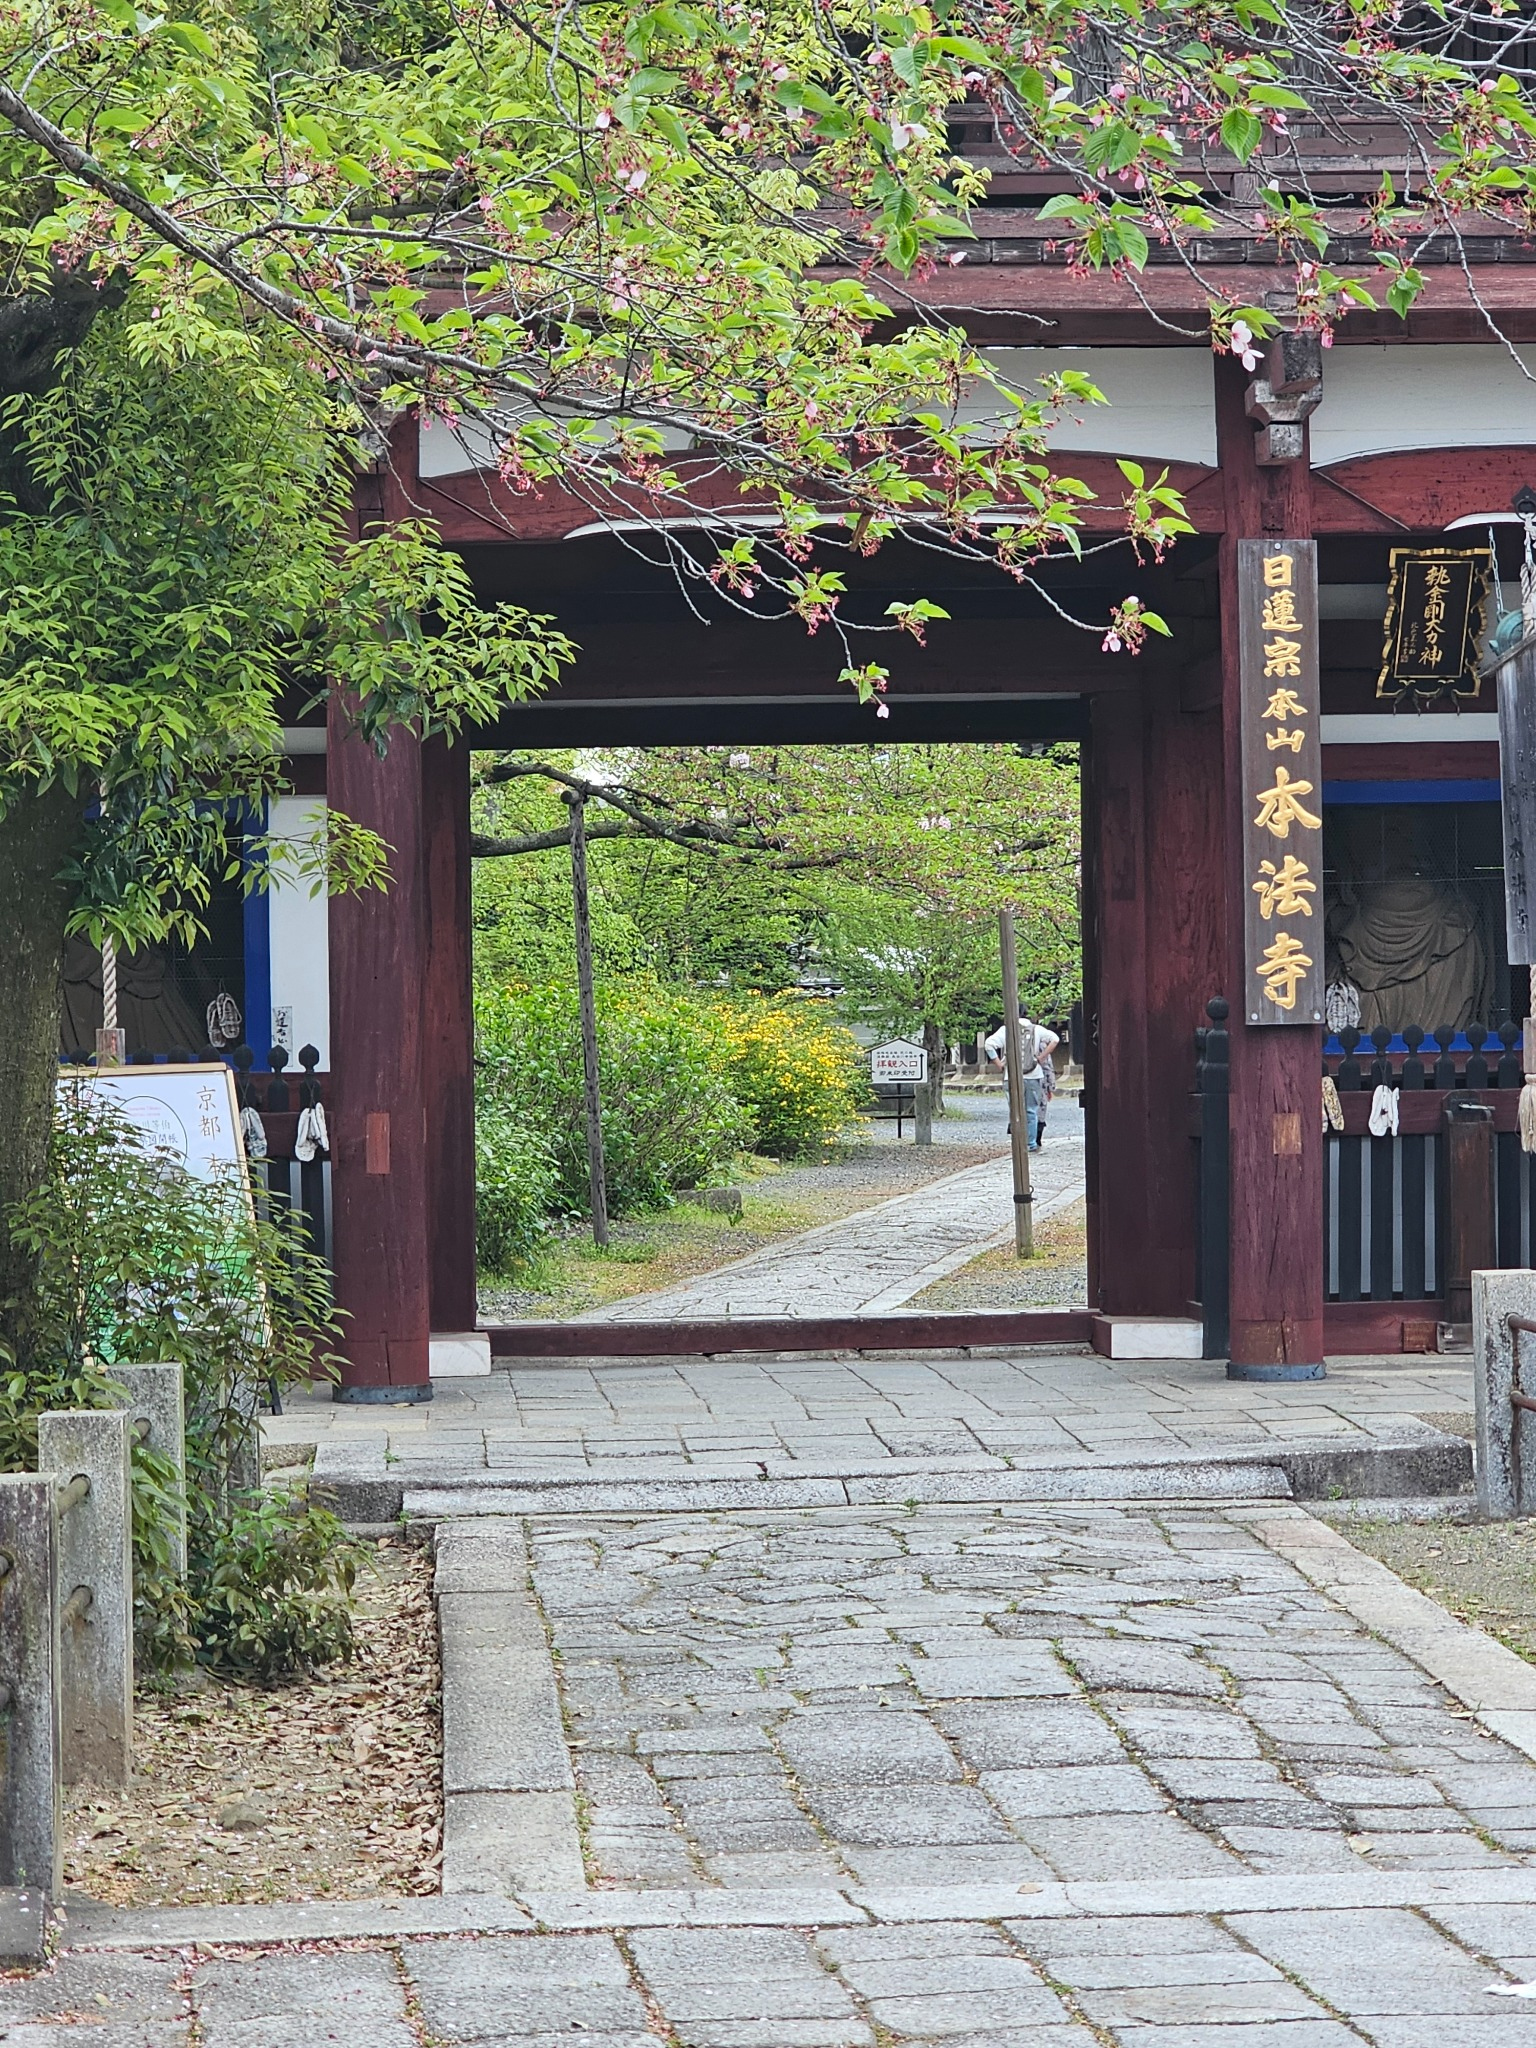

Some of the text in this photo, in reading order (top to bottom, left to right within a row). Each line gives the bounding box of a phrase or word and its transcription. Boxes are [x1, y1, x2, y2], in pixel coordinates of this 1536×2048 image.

[1252, 554, 1322, 1010] 日蓮宗本山本法寺
[876, 1060, 918, 1069] 拝観入口
[196, 1085, 221, 1141] 京都
